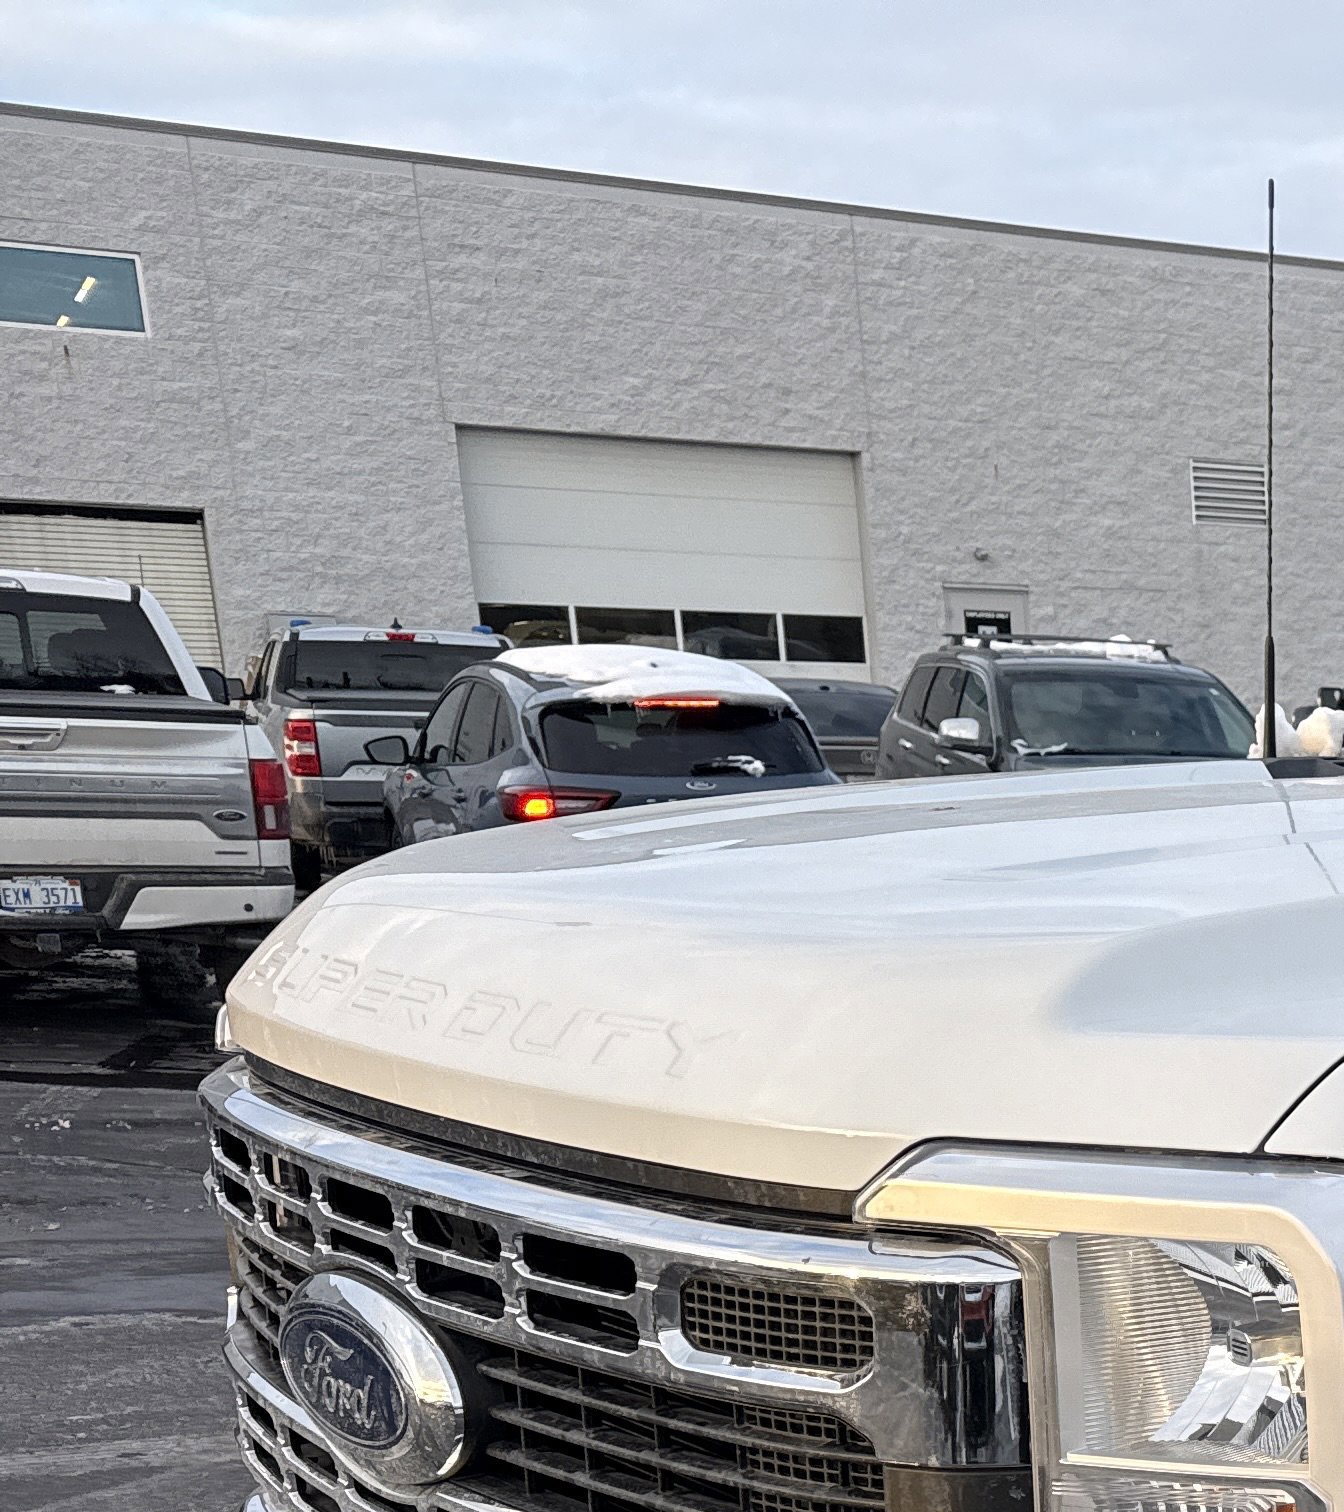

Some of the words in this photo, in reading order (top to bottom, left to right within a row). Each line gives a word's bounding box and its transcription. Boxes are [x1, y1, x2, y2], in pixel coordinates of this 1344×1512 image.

[41, 887, 80, 905] 3571
[249, 941, 449, 1031] SUPER
[442, 989, 746, 1079] DUTY
[303, 1330, 377, 1429] Ford
